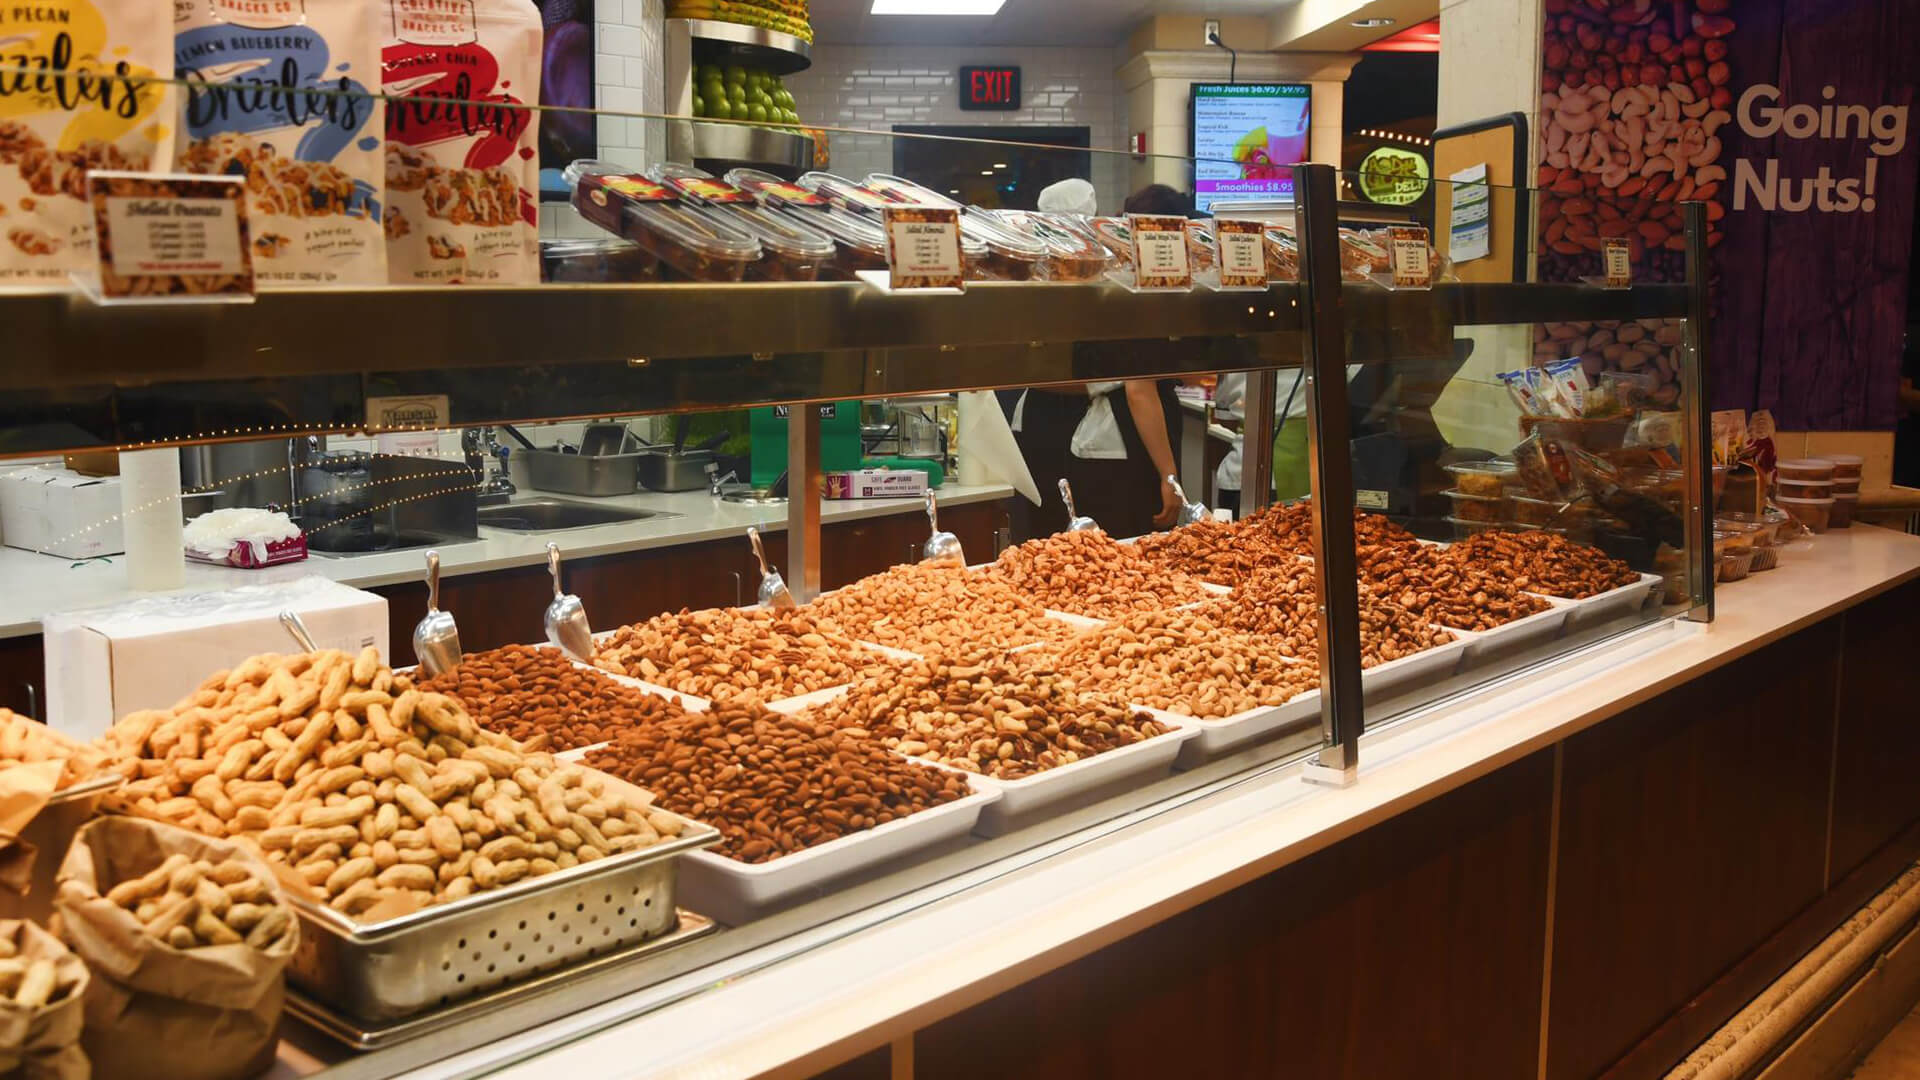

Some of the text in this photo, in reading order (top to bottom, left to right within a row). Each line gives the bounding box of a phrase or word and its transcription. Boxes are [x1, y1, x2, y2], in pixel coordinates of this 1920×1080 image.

[13, 7, 70, 23] PECAN
[175, 36, 313, 66] LEMON BLUEBERRY
[0, 32, 146, 118] izzlers
[175, 56, 359, 130] Drizzlers
[971, 71, 1013, 104] EXIT
[1199, 86, 1222, 94] Fresh
[1223, 86, 1249, 94] Juices
[383, 72, 521, 141] rizzlers
[1737, 83, 1909, 156] Going
[1215, 182, 1293, 191] Smoothies $8.95
[1733, 157, 1878, 212] Nuts!
